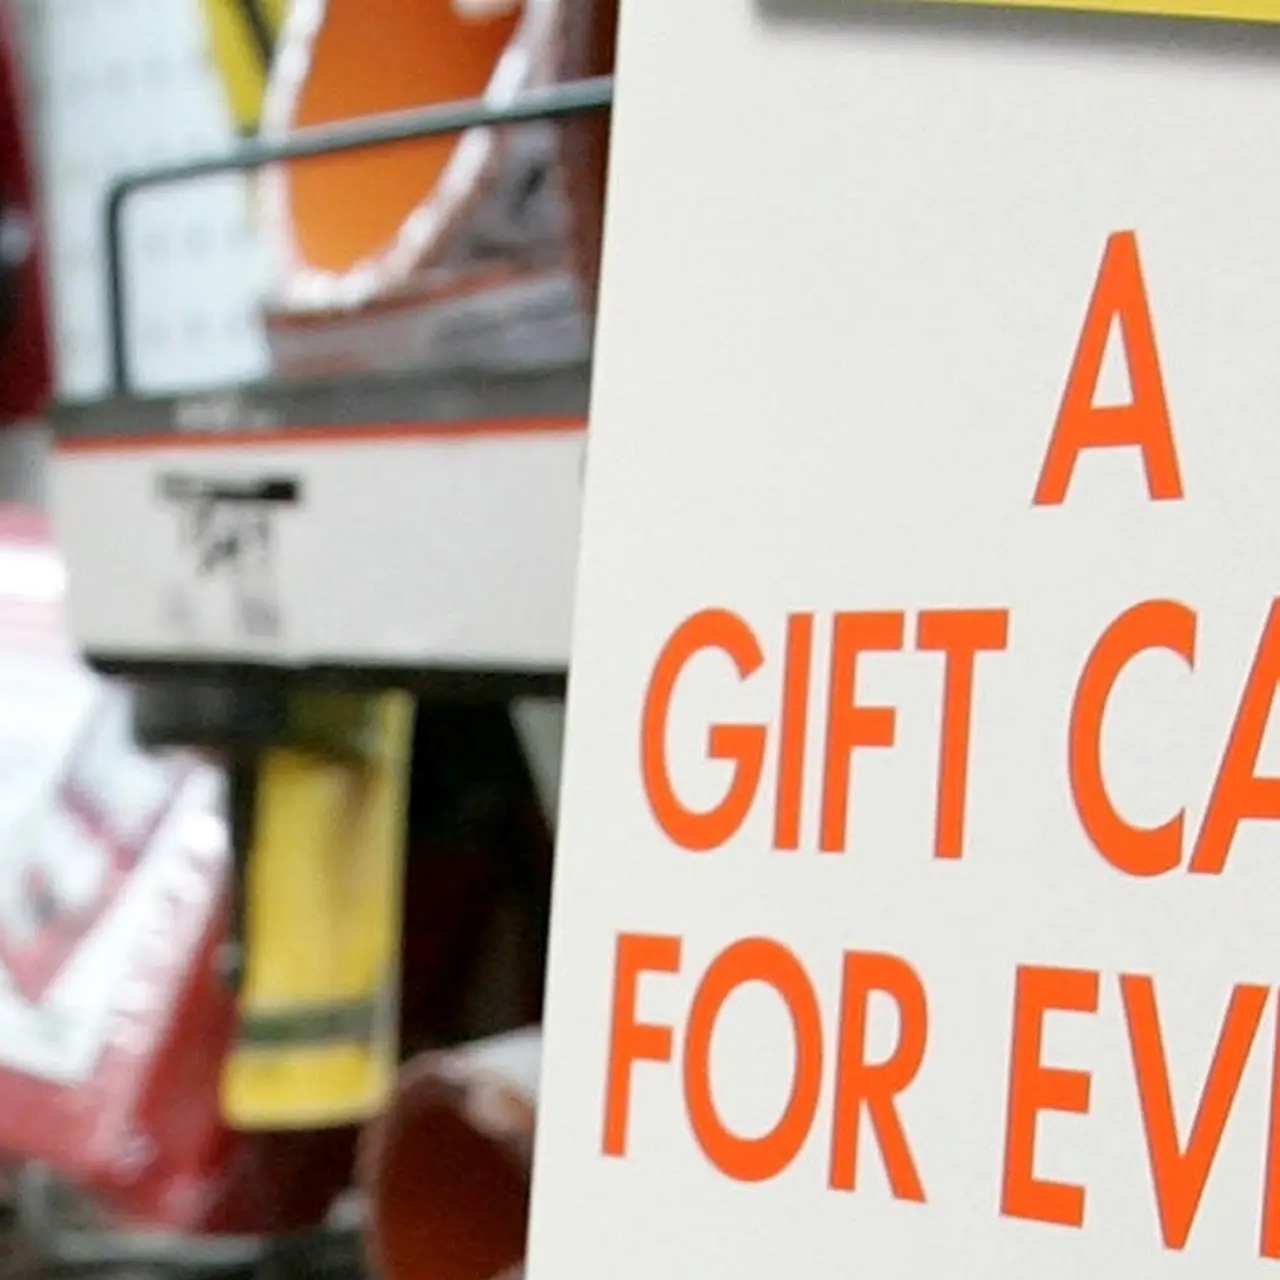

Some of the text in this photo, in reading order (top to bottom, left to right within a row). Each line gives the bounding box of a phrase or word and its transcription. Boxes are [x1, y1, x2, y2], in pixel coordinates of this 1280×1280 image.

[1030, 229, 1184, 506] A
[639, 597, 1280, 878] GIFT CA
[600, 931, 1280, 1260] FOR EV
